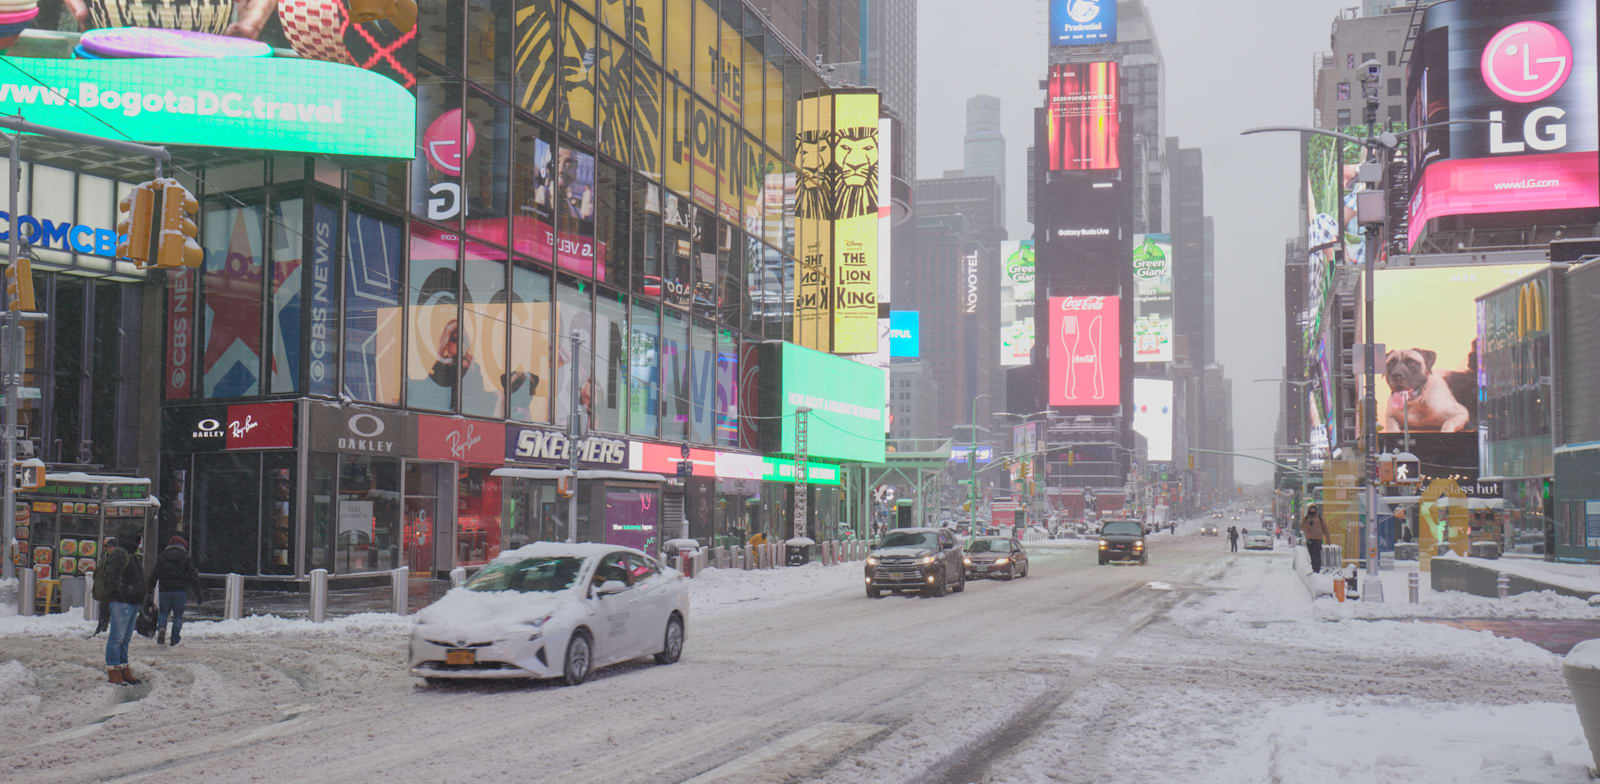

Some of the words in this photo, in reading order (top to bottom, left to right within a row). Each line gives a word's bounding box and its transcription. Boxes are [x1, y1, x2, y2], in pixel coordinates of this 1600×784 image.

[1064, 22, 1102, 32] Prudential
[708, 45, 740, 104] THE
[1489, 106, 1567, 154] LG
[1494, 178, 1560, 190] www.LG.com
[313, 222, 329, 302] NEWS
[842, 252, 866, 263] THE
[1133, 260, 1165, 268] Green
[839, 266, 871, 285] LION
[966, 249, 978, 313] NOVOTEL
[1136, 267, 1166, 276] Giant
[836, 287, 875, 309] KING
[173, 318, 187, 366] CBS
[311, 307, 327, 360] CBS
[338, 437, 393, 452] OAKLEY
[1476, 482, 1498, 495] hut
